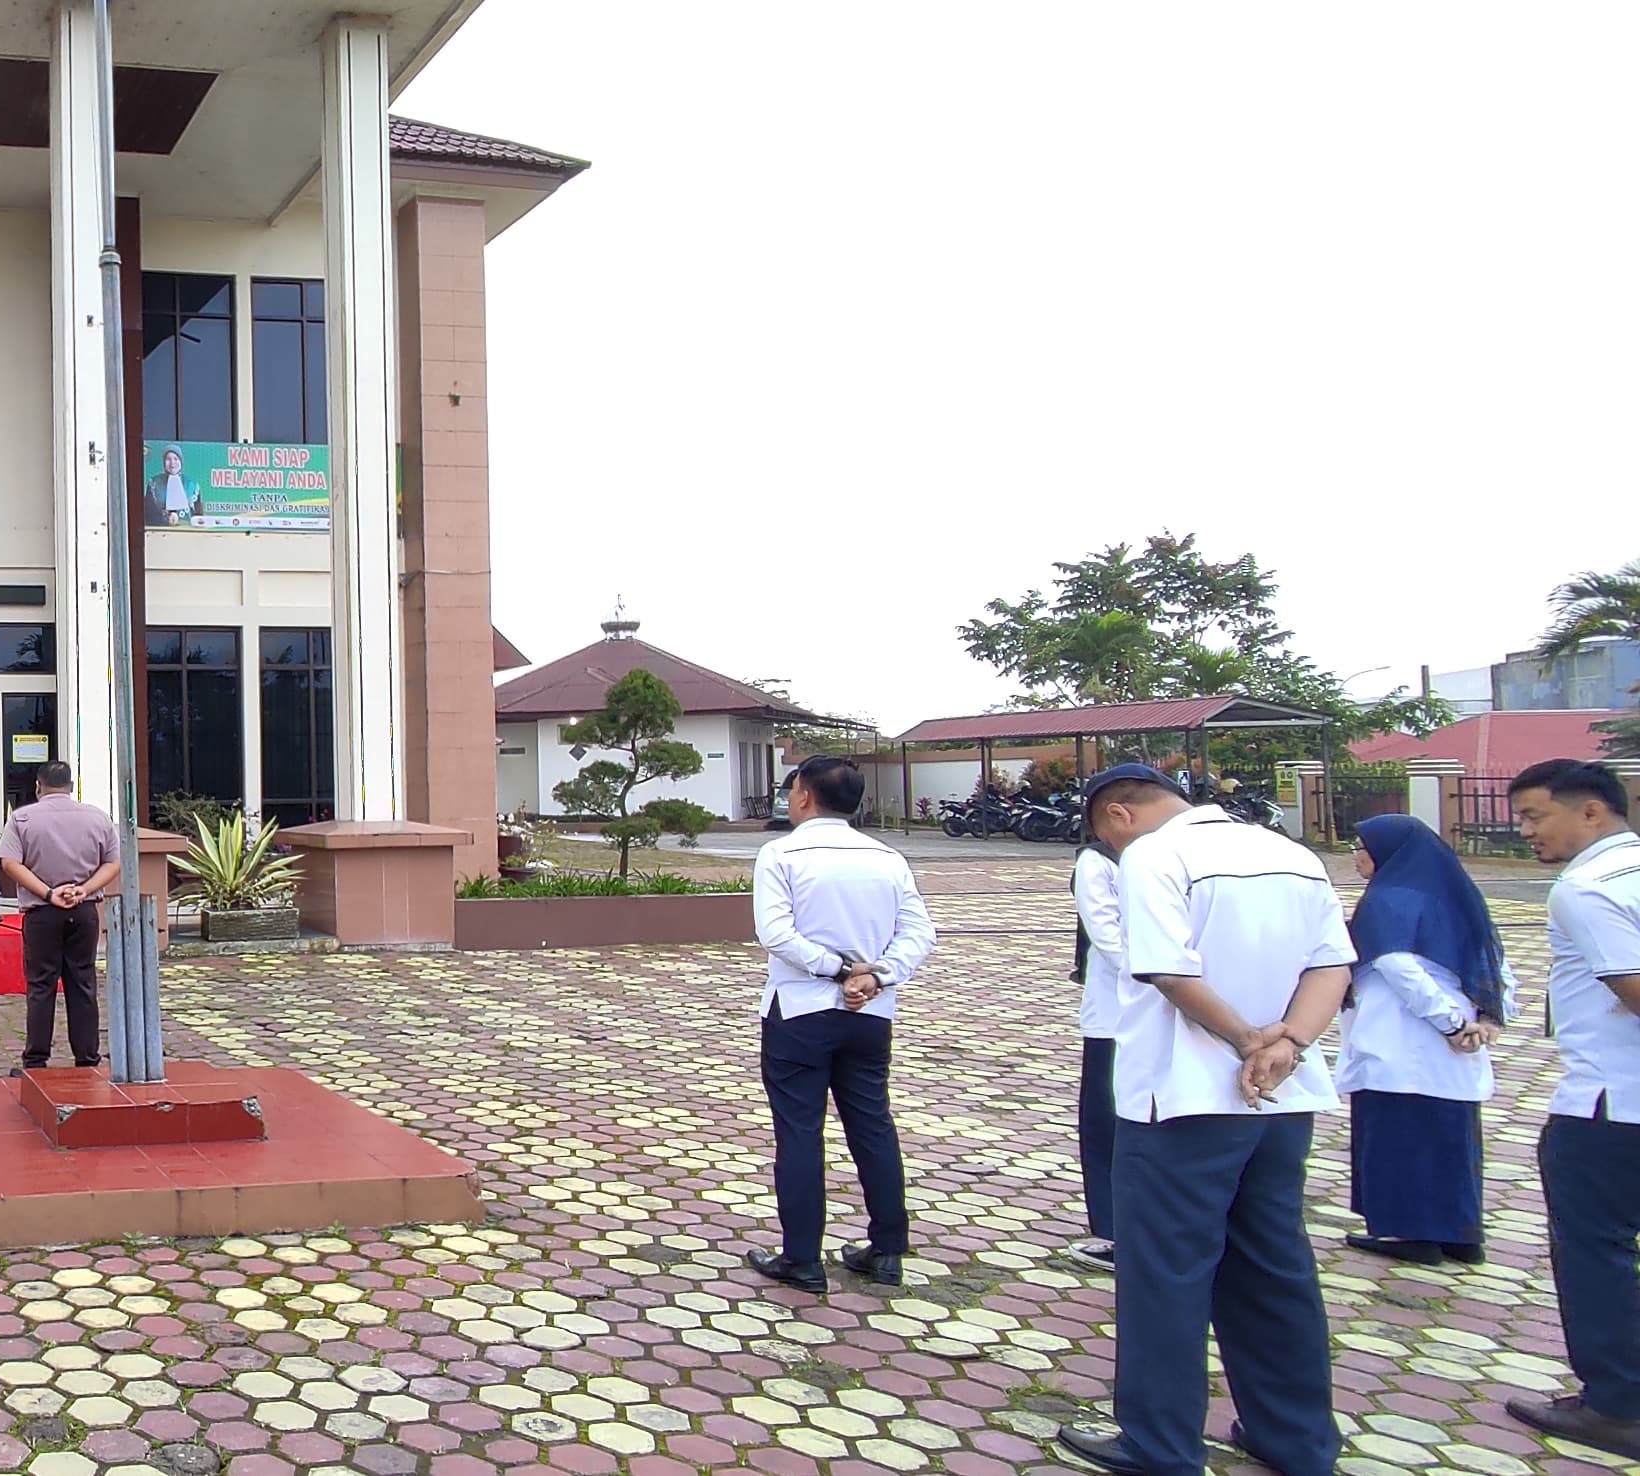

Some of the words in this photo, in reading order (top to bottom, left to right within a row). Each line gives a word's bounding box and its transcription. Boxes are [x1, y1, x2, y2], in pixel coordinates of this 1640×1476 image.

[228, 447, 269, 467] KAMI
[274, 448, 310, 468] SIAP
[211, 470, 283, 489] MELAYANI
[287, 472, 326, 489] ANDA
[251, 493, 288, 503] TANPA
